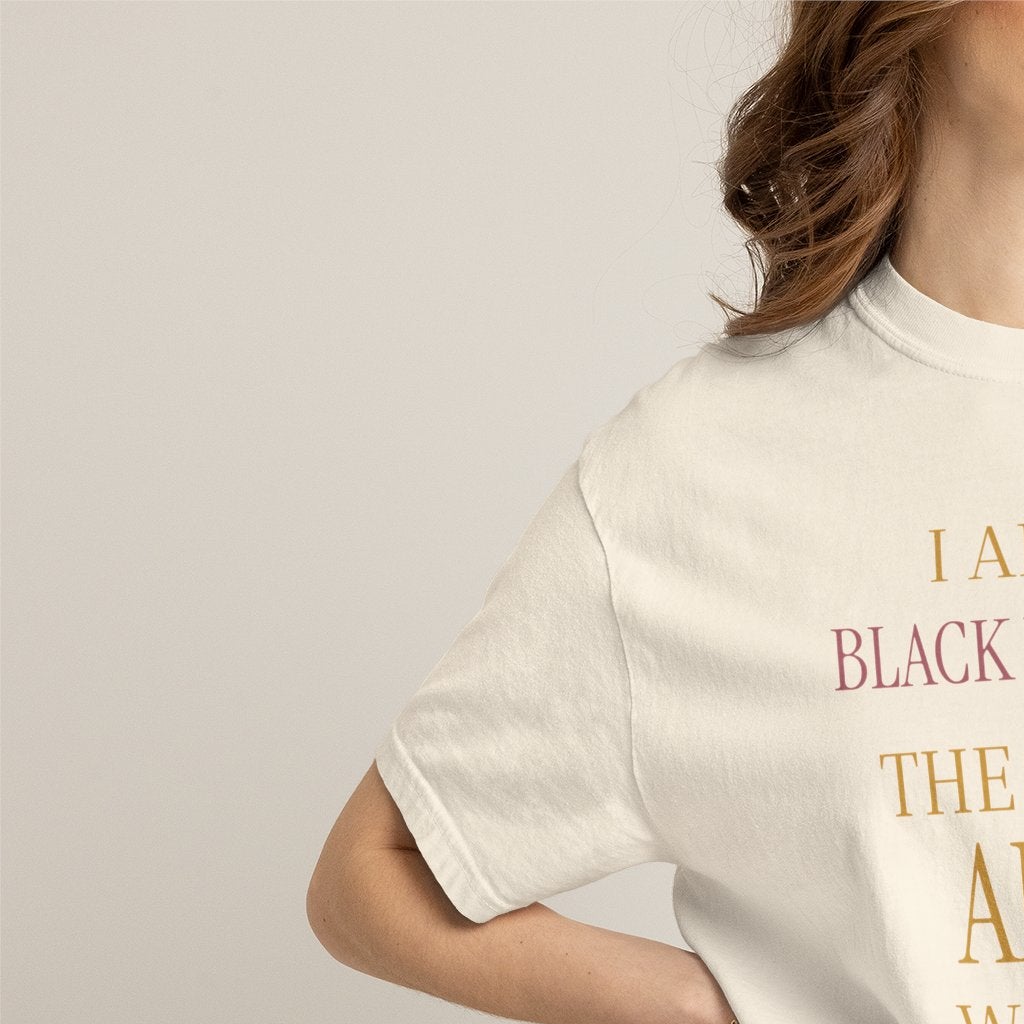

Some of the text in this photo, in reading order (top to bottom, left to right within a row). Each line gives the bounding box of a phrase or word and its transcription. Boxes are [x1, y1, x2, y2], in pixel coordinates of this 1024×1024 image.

[928, 528, 948, 582] I
[830, 618, 1015, 691] BLACK
[879, 745, 1015, 818] THE
